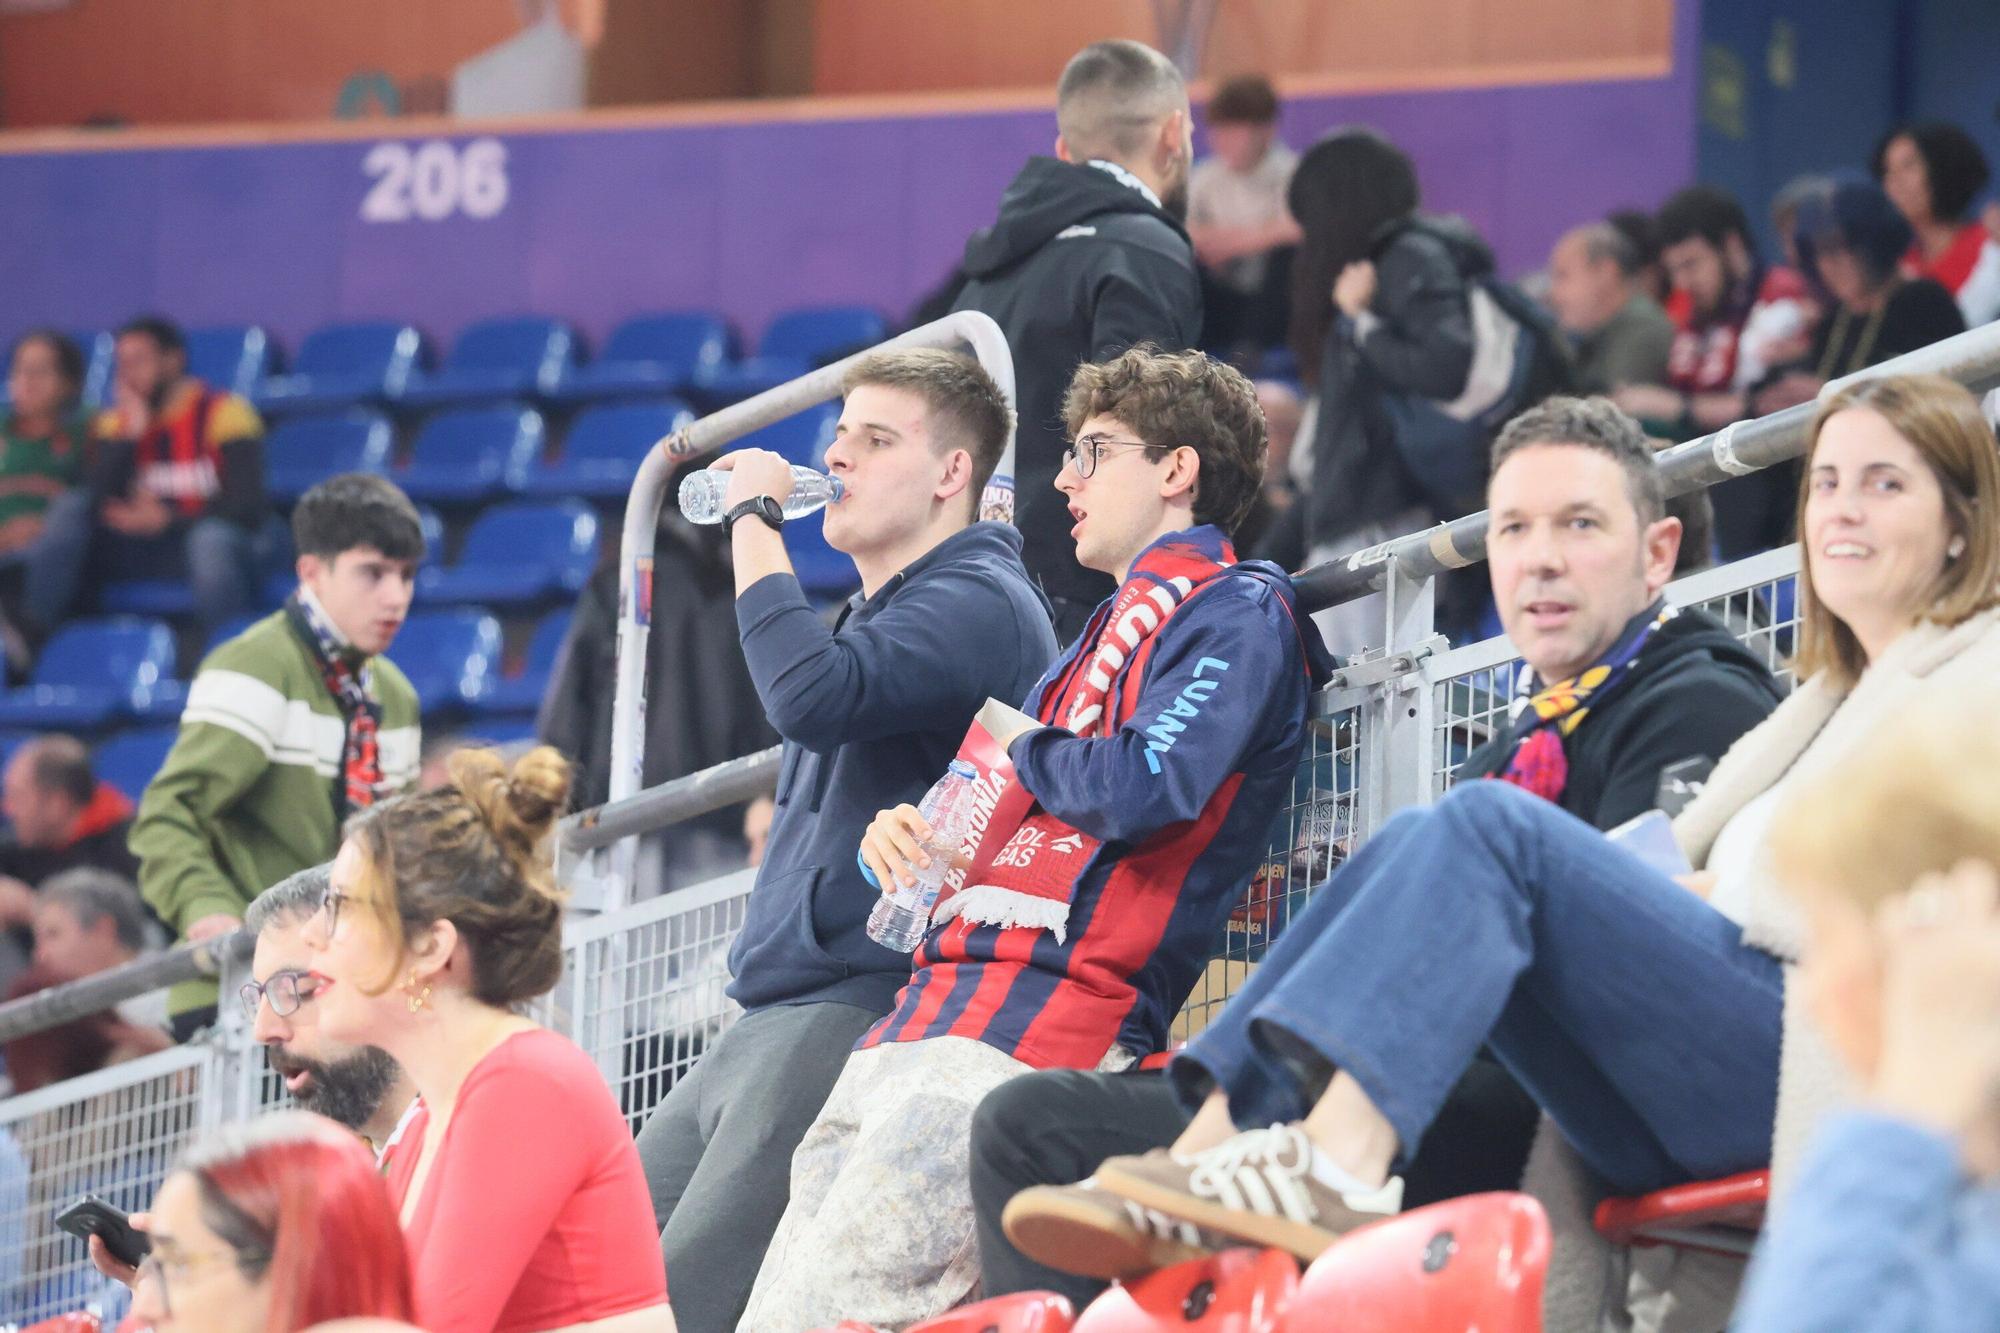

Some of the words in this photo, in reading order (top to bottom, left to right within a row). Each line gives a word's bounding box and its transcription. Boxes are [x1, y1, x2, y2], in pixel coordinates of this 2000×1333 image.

[361, 141, 508, 221] 206
[1092, 585, 1140, 666] EUROLEA
[991, 846, 1036, 868] GAS
